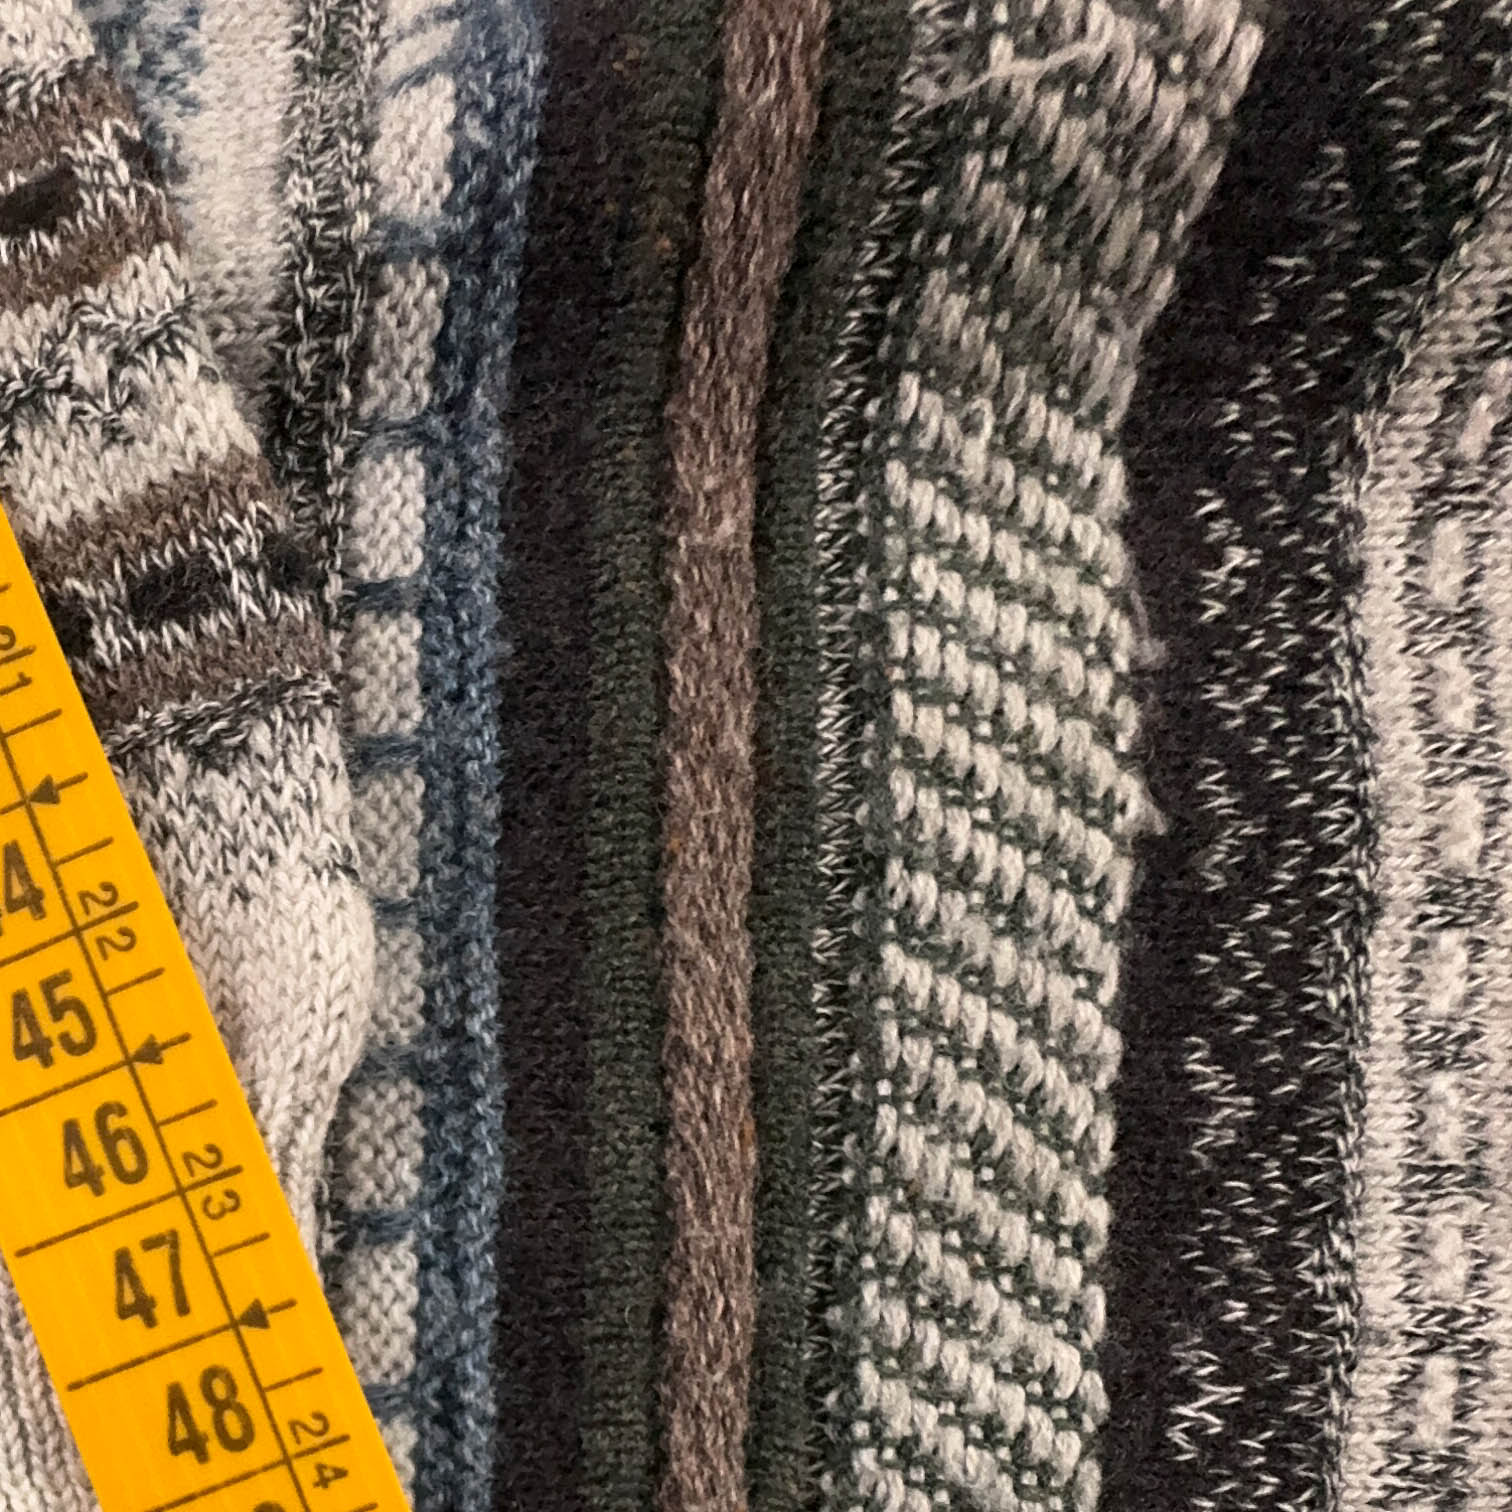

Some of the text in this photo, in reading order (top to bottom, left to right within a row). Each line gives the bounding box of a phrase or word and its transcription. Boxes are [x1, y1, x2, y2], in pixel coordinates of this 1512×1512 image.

[11, 969, 98, 1069] 45
[62, 1101, 148, 1197] 46
[114, 1229, 191, 1330] 47
[166, 1365, 255, 1464] 48
